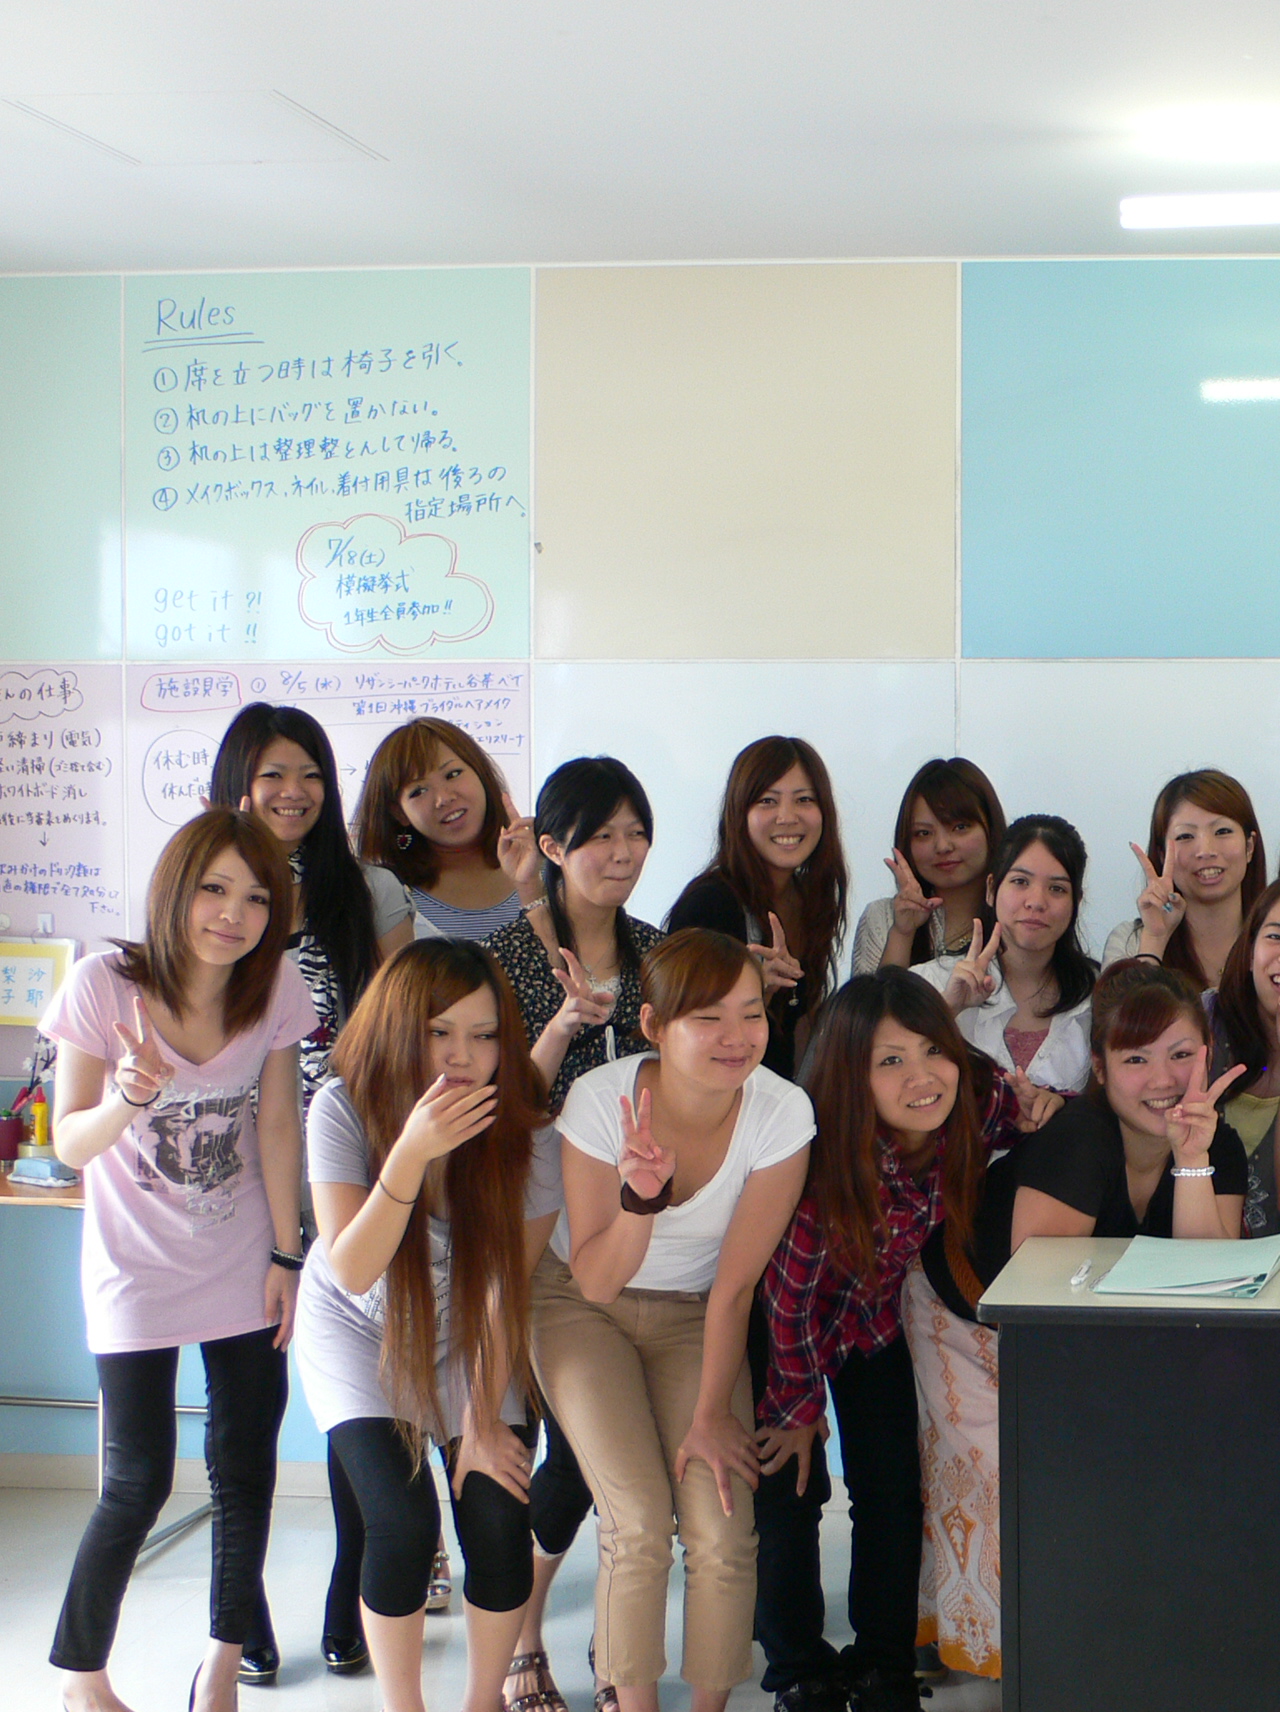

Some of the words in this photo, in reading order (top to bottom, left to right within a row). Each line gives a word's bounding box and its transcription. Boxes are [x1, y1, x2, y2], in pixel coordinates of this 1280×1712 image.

[156, 296, 236, 336] Rules
[336, 569, 411, 599] 模擬挙式
[154, 587, 199, 613] get
[209, 590, 234, 612] it
[155, 623, 197, 648] got
[207, 624, 231, 643] it
[244, 622, 258, 644] !!
[0, 677, 73, 705] んの仕事
[156, 675, 234, 699] 施設見学
